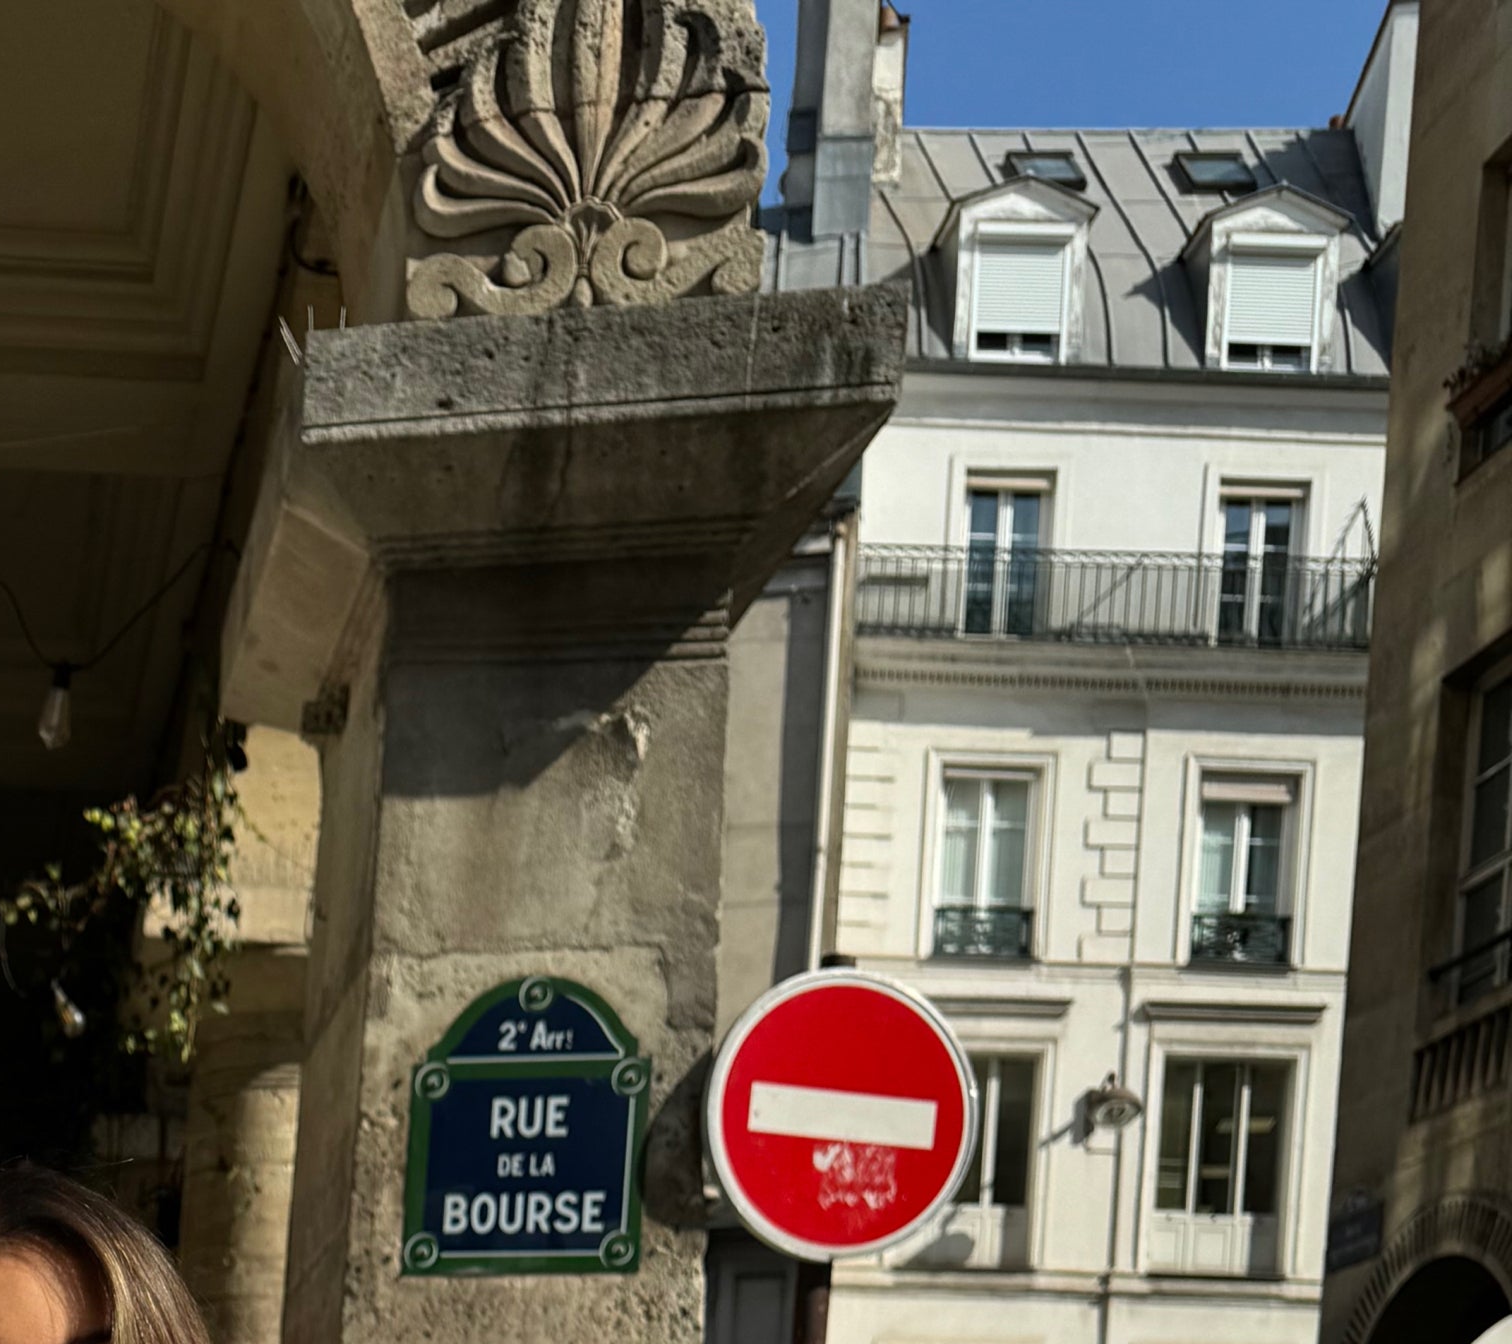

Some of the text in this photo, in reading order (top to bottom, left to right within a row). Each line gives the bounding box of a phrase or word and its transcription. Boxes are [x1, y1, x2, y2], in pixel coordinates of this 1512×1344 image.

[490, 1095, 570, 1139] RUE
[496, 1152, 555, 1178] DE LA
[442, 1190, 606, 1235] BOURSE
